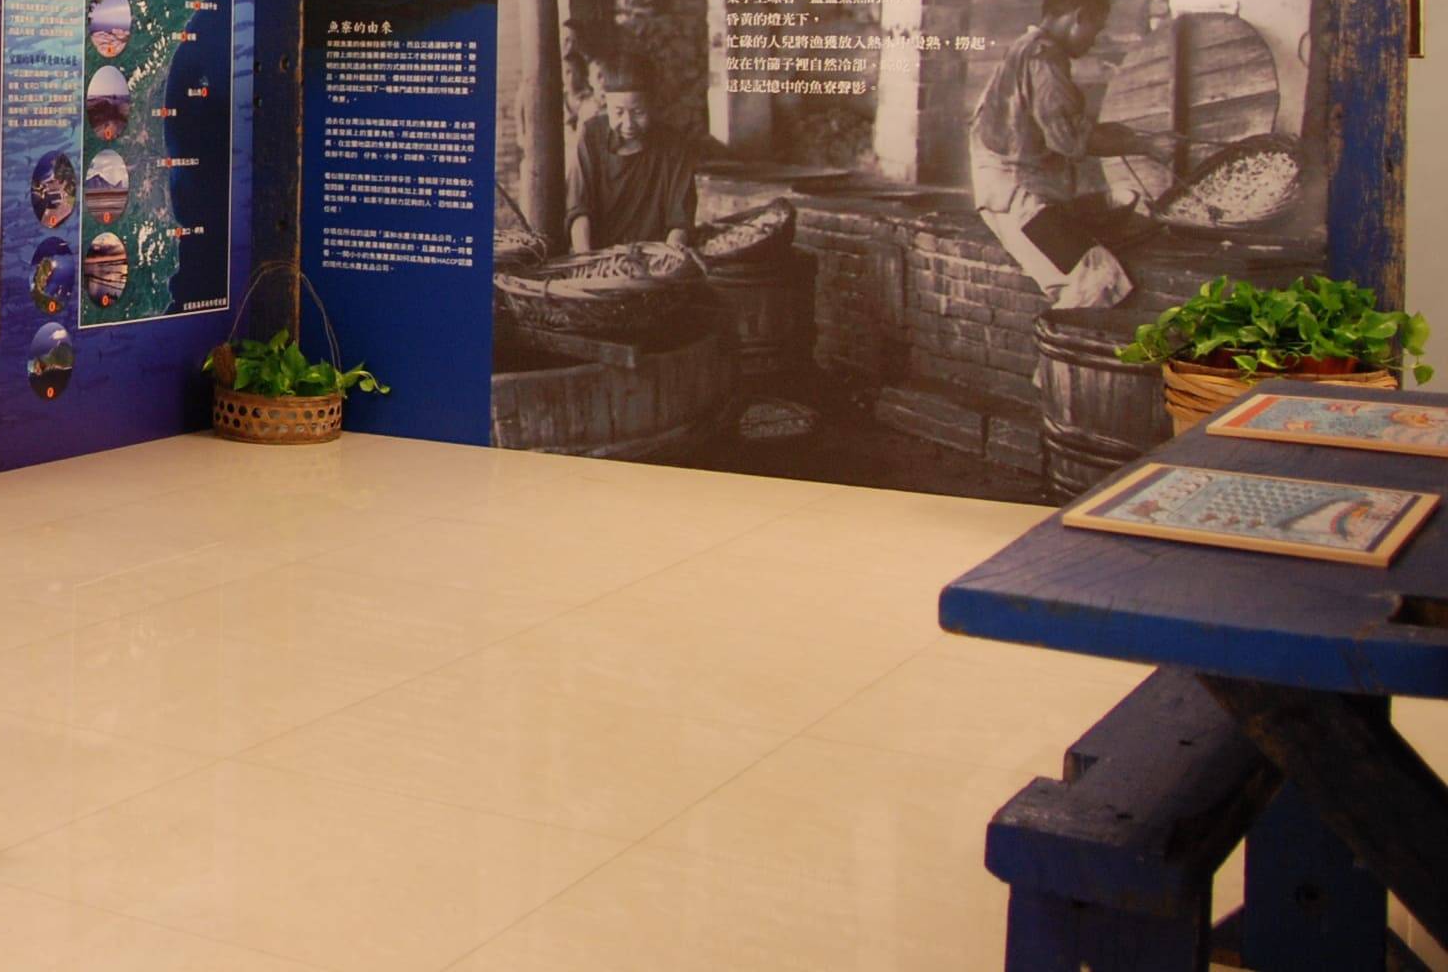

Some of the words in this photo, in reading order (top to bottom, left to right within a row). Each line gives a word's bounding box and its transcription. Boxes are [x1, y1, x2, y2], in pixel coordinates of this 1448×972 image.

[327, 20, 393, 35] 魚寮的由來
[726, 79, 878, 95] 這是記憶中的魚寮聲影。
